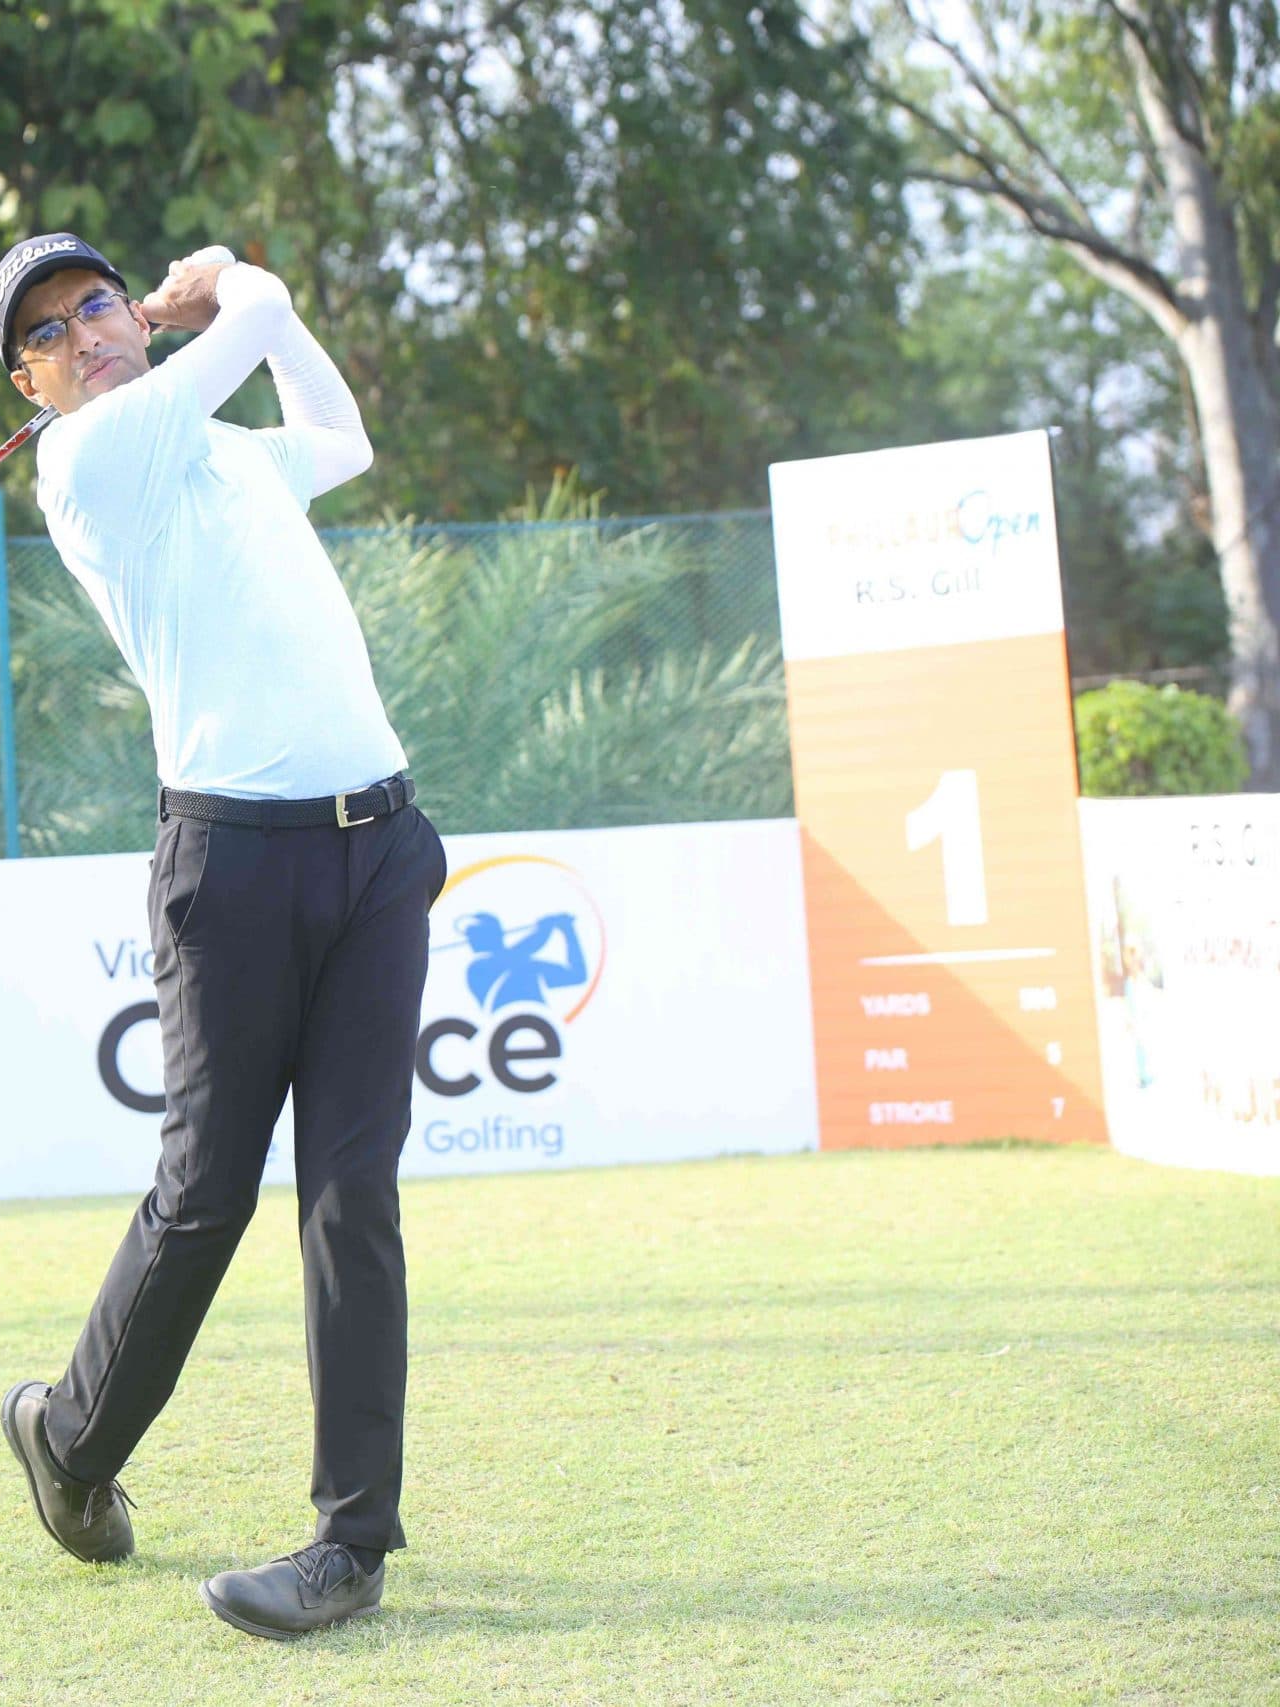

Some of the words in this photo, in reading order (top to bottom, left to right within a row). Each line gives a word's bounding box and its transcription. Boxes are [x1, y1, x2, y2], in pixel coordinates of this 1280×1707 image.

[906, 769, 988, 926] 1
[860, 990, 932, 1017] YARDS
[864, 1046, 909, 1071] PAR
[868, 1100, 954, 1125] STROKE
[423, 1113, 564, 1157] Golfing
